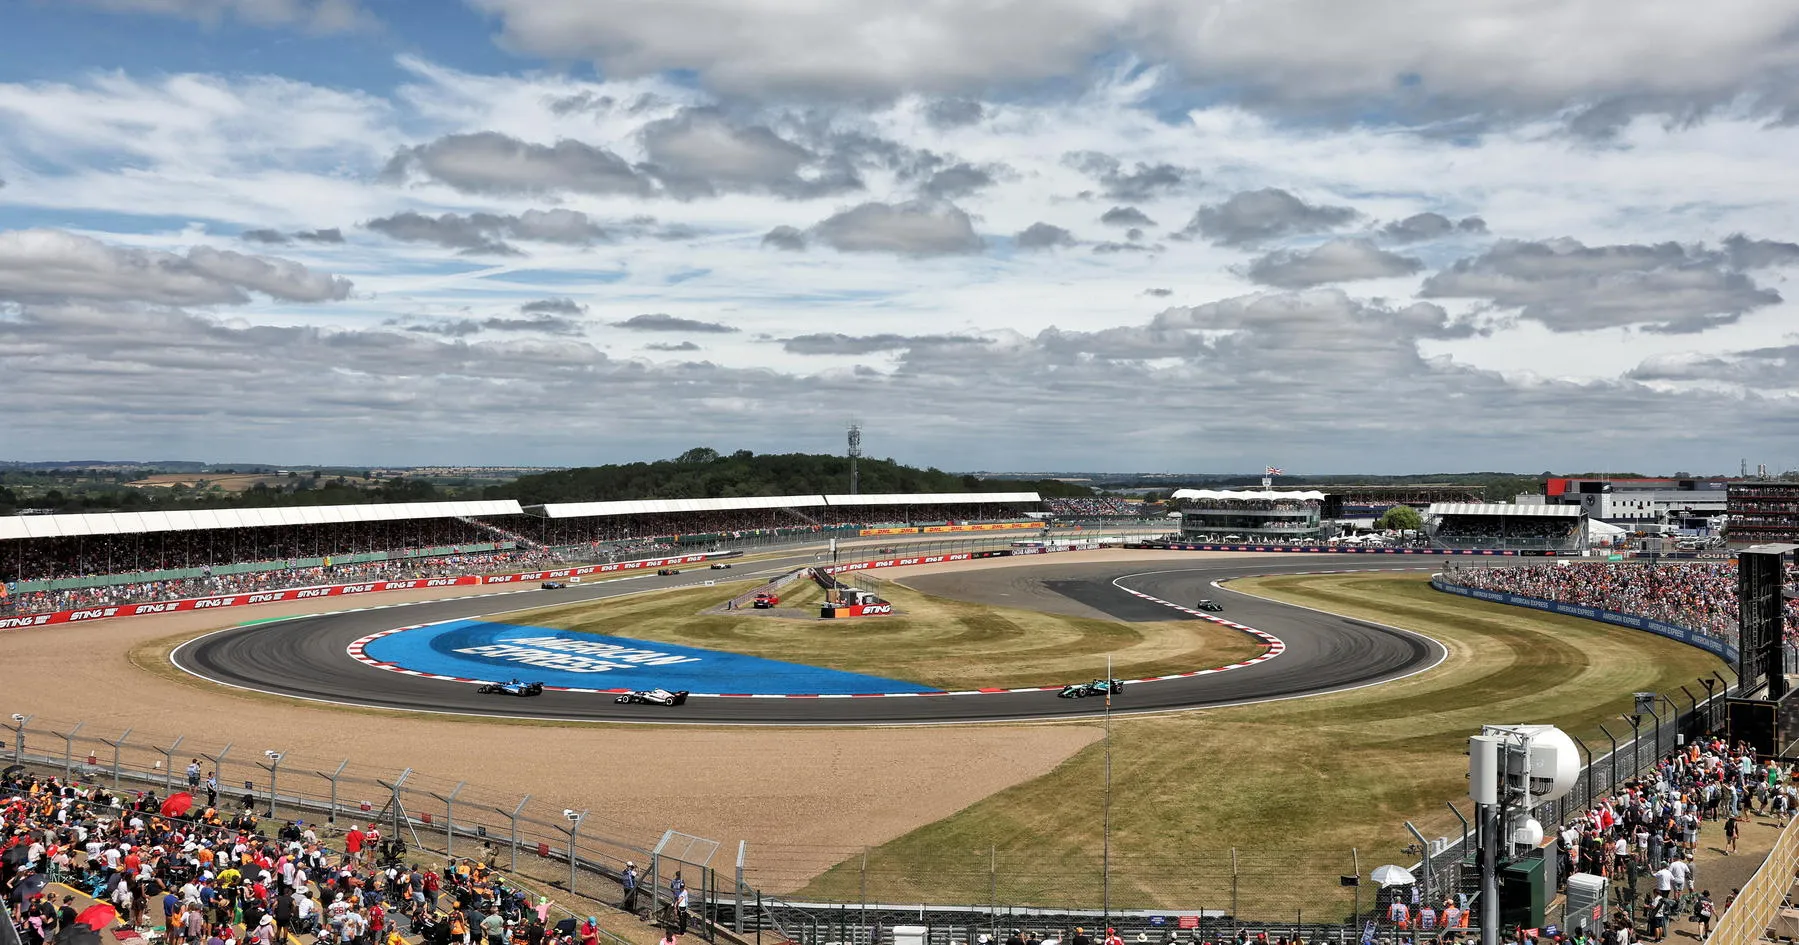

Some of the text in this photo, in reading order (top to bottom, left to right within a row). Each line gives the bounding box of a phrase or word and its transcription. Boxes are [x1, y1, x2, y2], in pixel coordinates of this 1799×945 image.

[194, 598, 221, 608] STING
[249, 594, 273, 603] STING
[136, 604, 165, 614] STING
[862, 605, 891, 614] STING
[1577, 609, 1594, 617] EXPRESS
[70, 609, 102, 620] STING
[1603, 612, 1640, 626] AMERICAN EXPRESS
[0, 617, 32, 627] STING
[1648, 623, 1684, 638] AMERICAN EXPRESS
[498, 637, 702, 665] AMERICAN
[452, 644, 638, 672] EXPRESS
